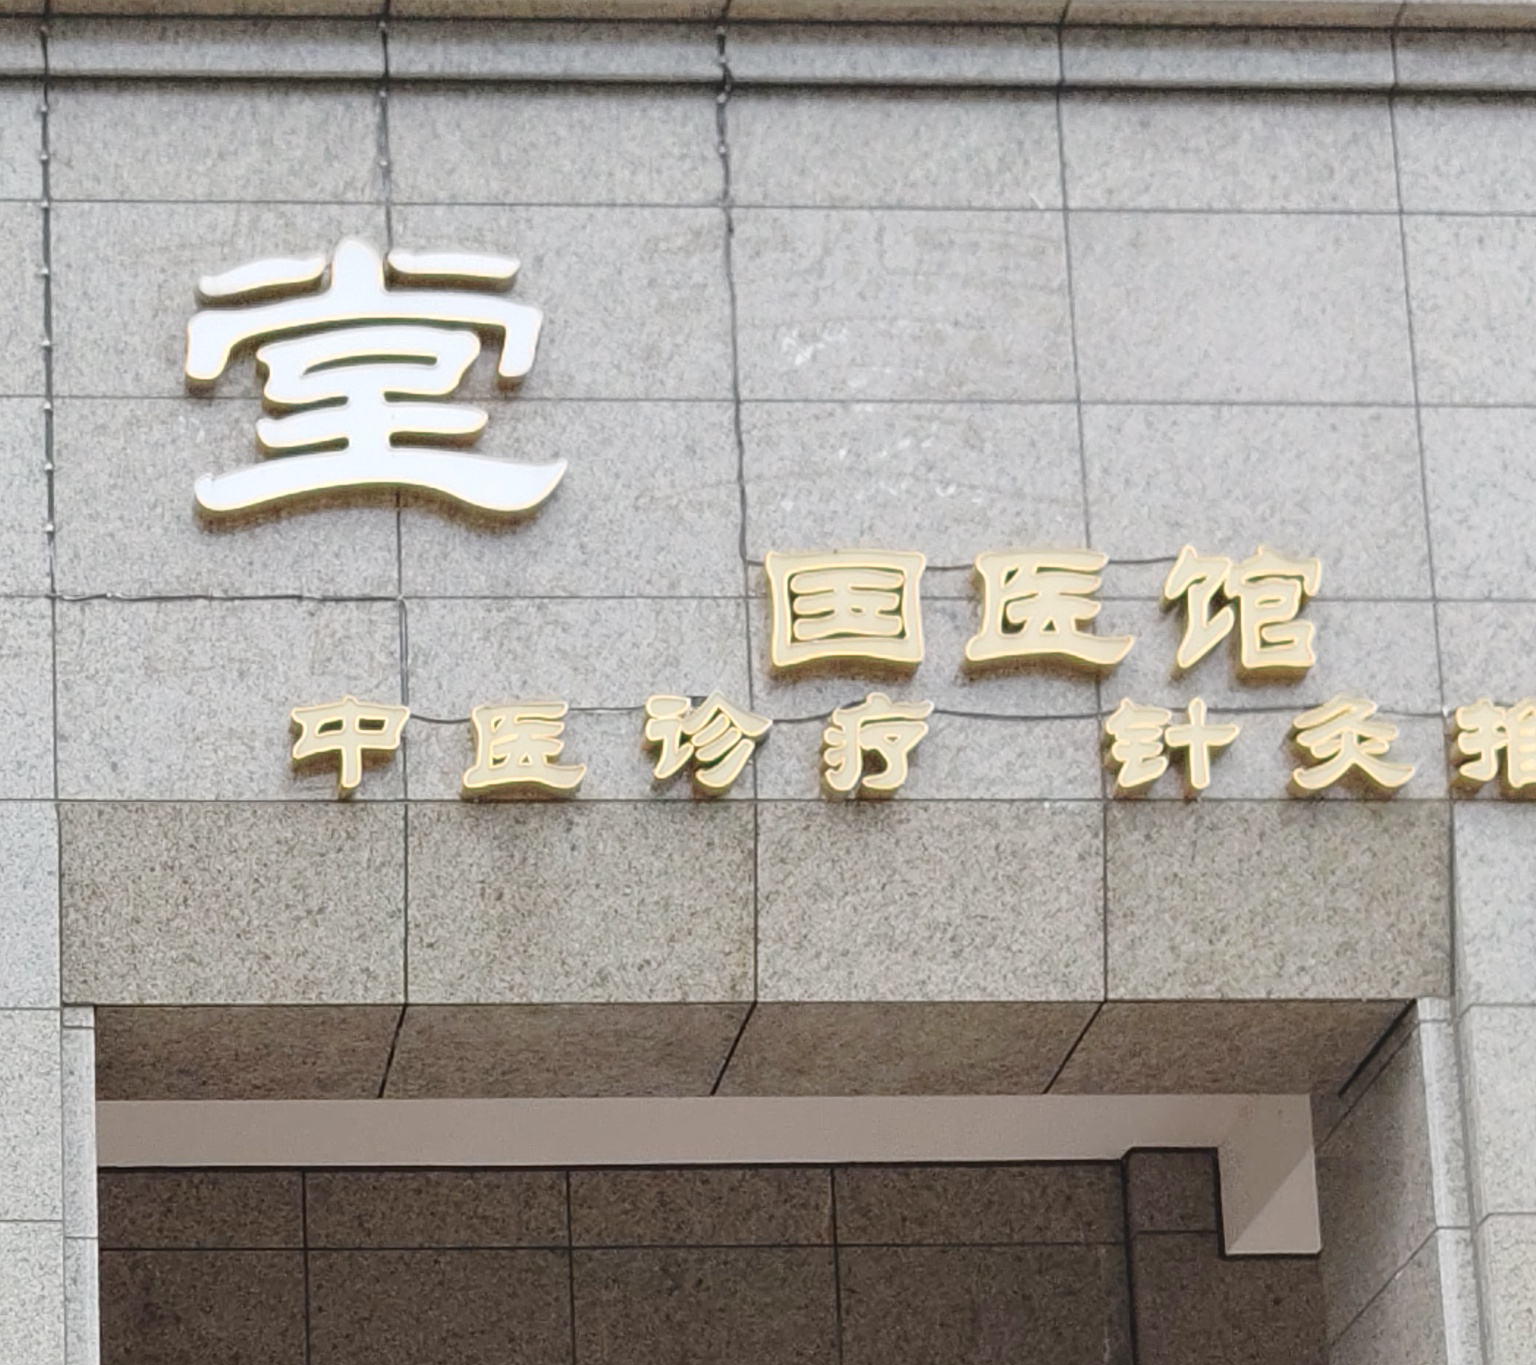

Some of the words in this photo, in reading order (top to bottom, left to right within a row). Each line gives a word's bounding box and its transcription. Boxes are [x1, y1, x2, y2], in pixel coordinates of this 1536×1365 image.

[764, 544, 1324, 682] 国医馆
[290, 693, 936, 798] 中医诊疗
[1104, 693, 1536, 798] 针灸推
